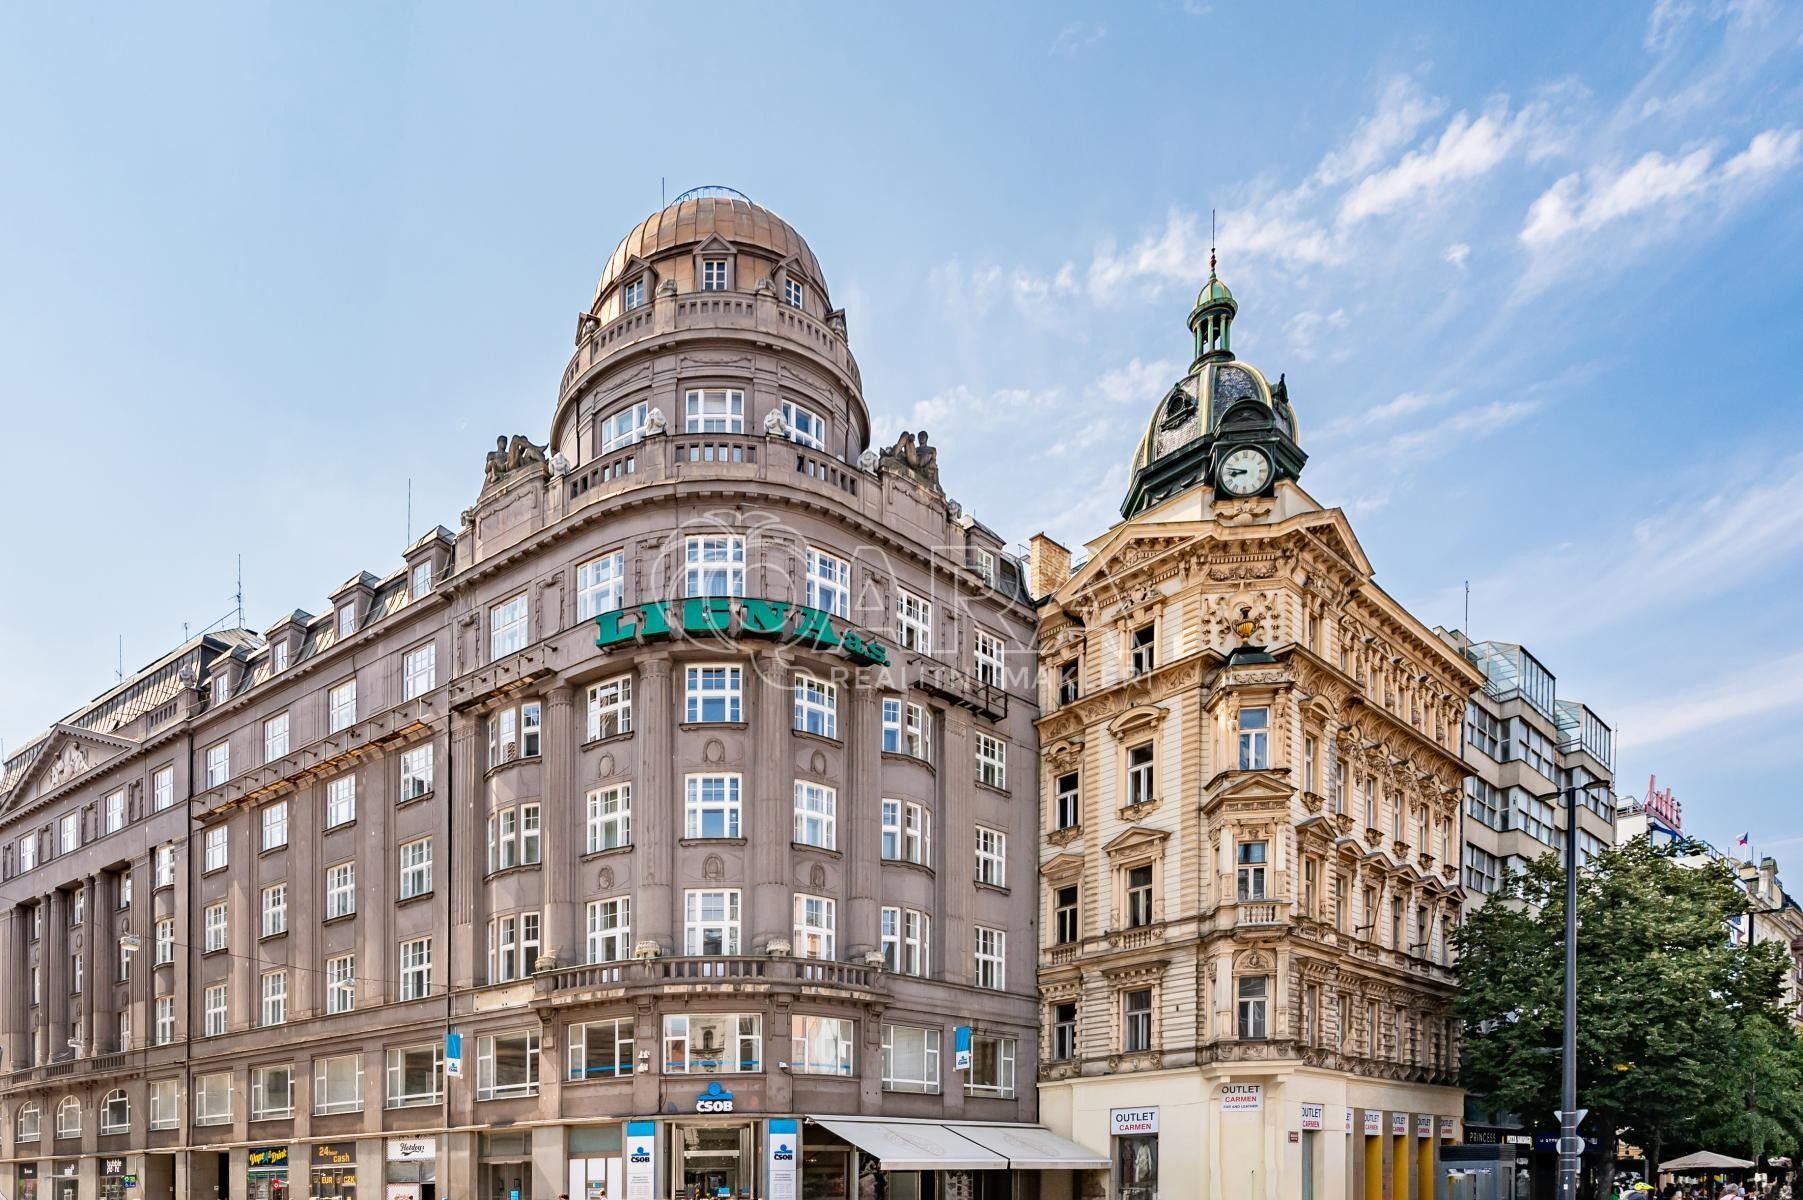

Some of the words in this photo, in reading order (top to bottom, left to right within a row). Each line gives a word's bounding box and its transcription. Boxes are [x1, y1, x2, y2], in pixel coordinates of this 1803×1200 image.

[595, 597, 842, 650] LIGNA
[1222, 1085, 1260, 1093] OUTLET
[696, 1100, 733, 1112] ČSOB
[1115, 1112, 1155, 1122] OUTLET
[1469, 1132, 1496, 1142] PRINCESS
[319, 1147, 328, 1156] 24
[333, 1153, 350, 1162] cash
[321, 1176, 332, 1184] EUR
